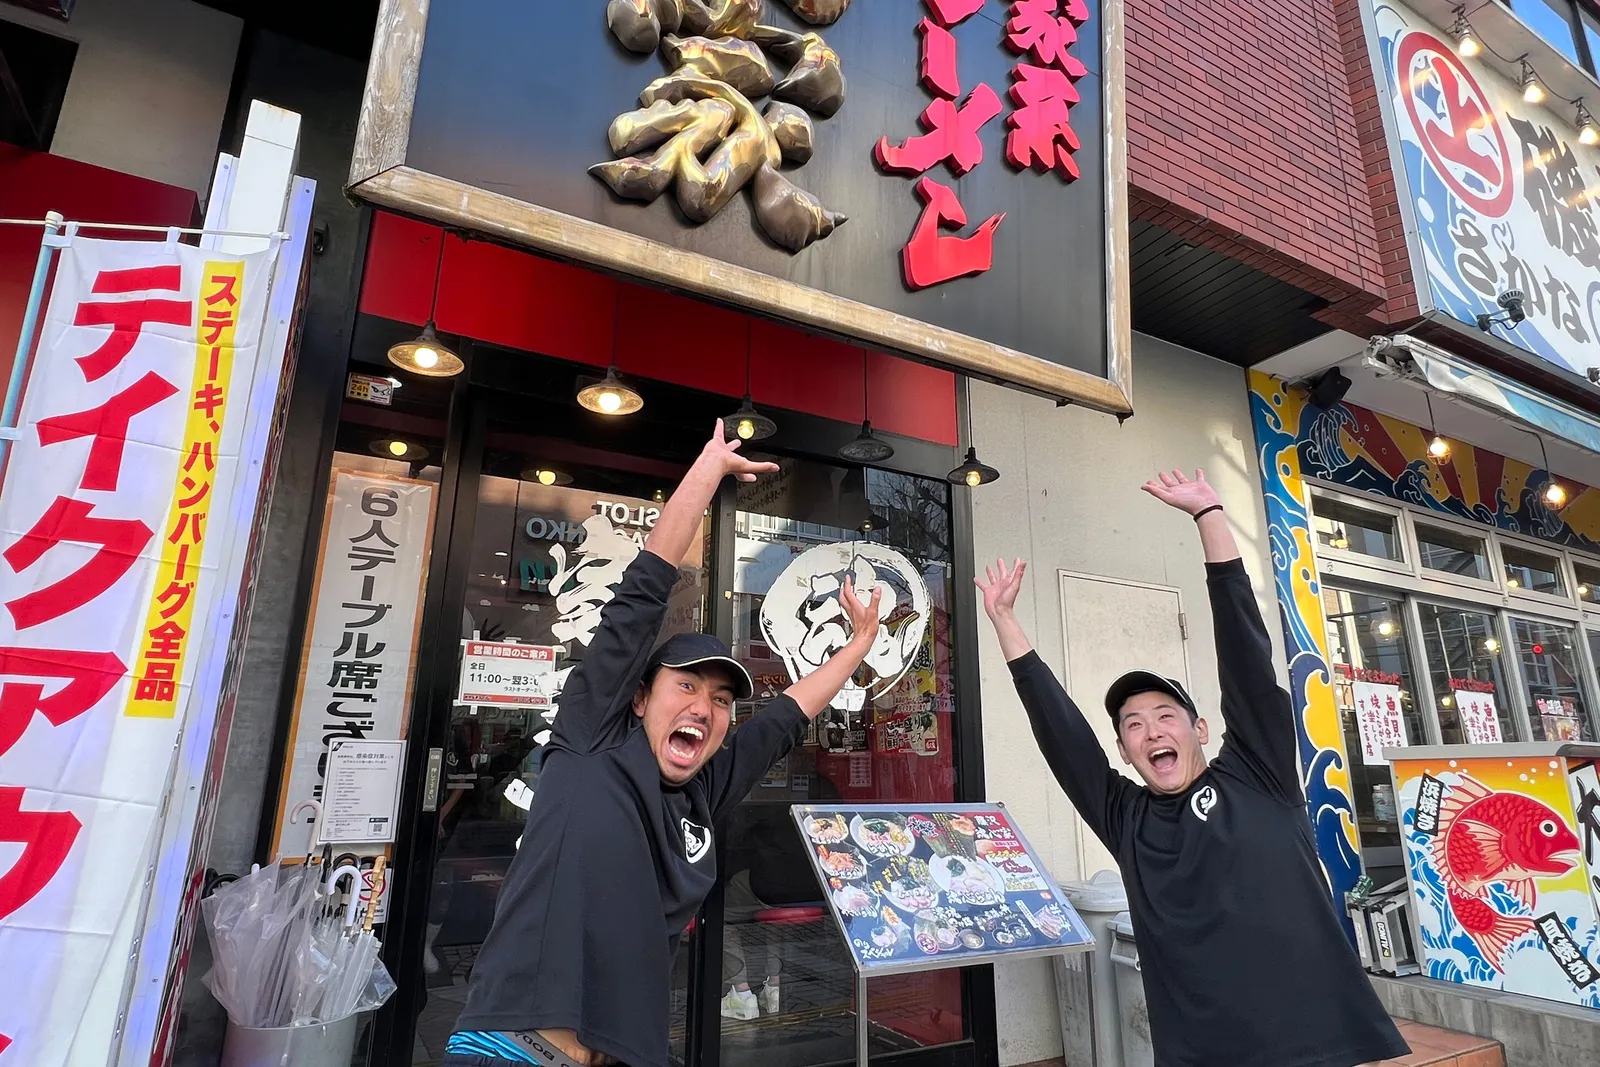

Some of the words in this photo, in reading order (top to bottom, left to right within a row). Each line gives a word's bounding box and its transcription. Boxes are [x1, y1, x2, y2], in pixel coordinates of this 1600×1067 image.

[874, 0, 1008, 292] ーメン
[1451, 217, 1592, 344] さかな
[133, 273, 238, 703] ステーキ、ハンバーグ全品
[0, 264, 192, 1057] テイクアウ
[470, 662, 486, 671] 全日
[473, 645, 548, 660] 営業時間のご案内
[853, 938, 871, 949] のり
[861, 947, 894, 960] スペシャル
